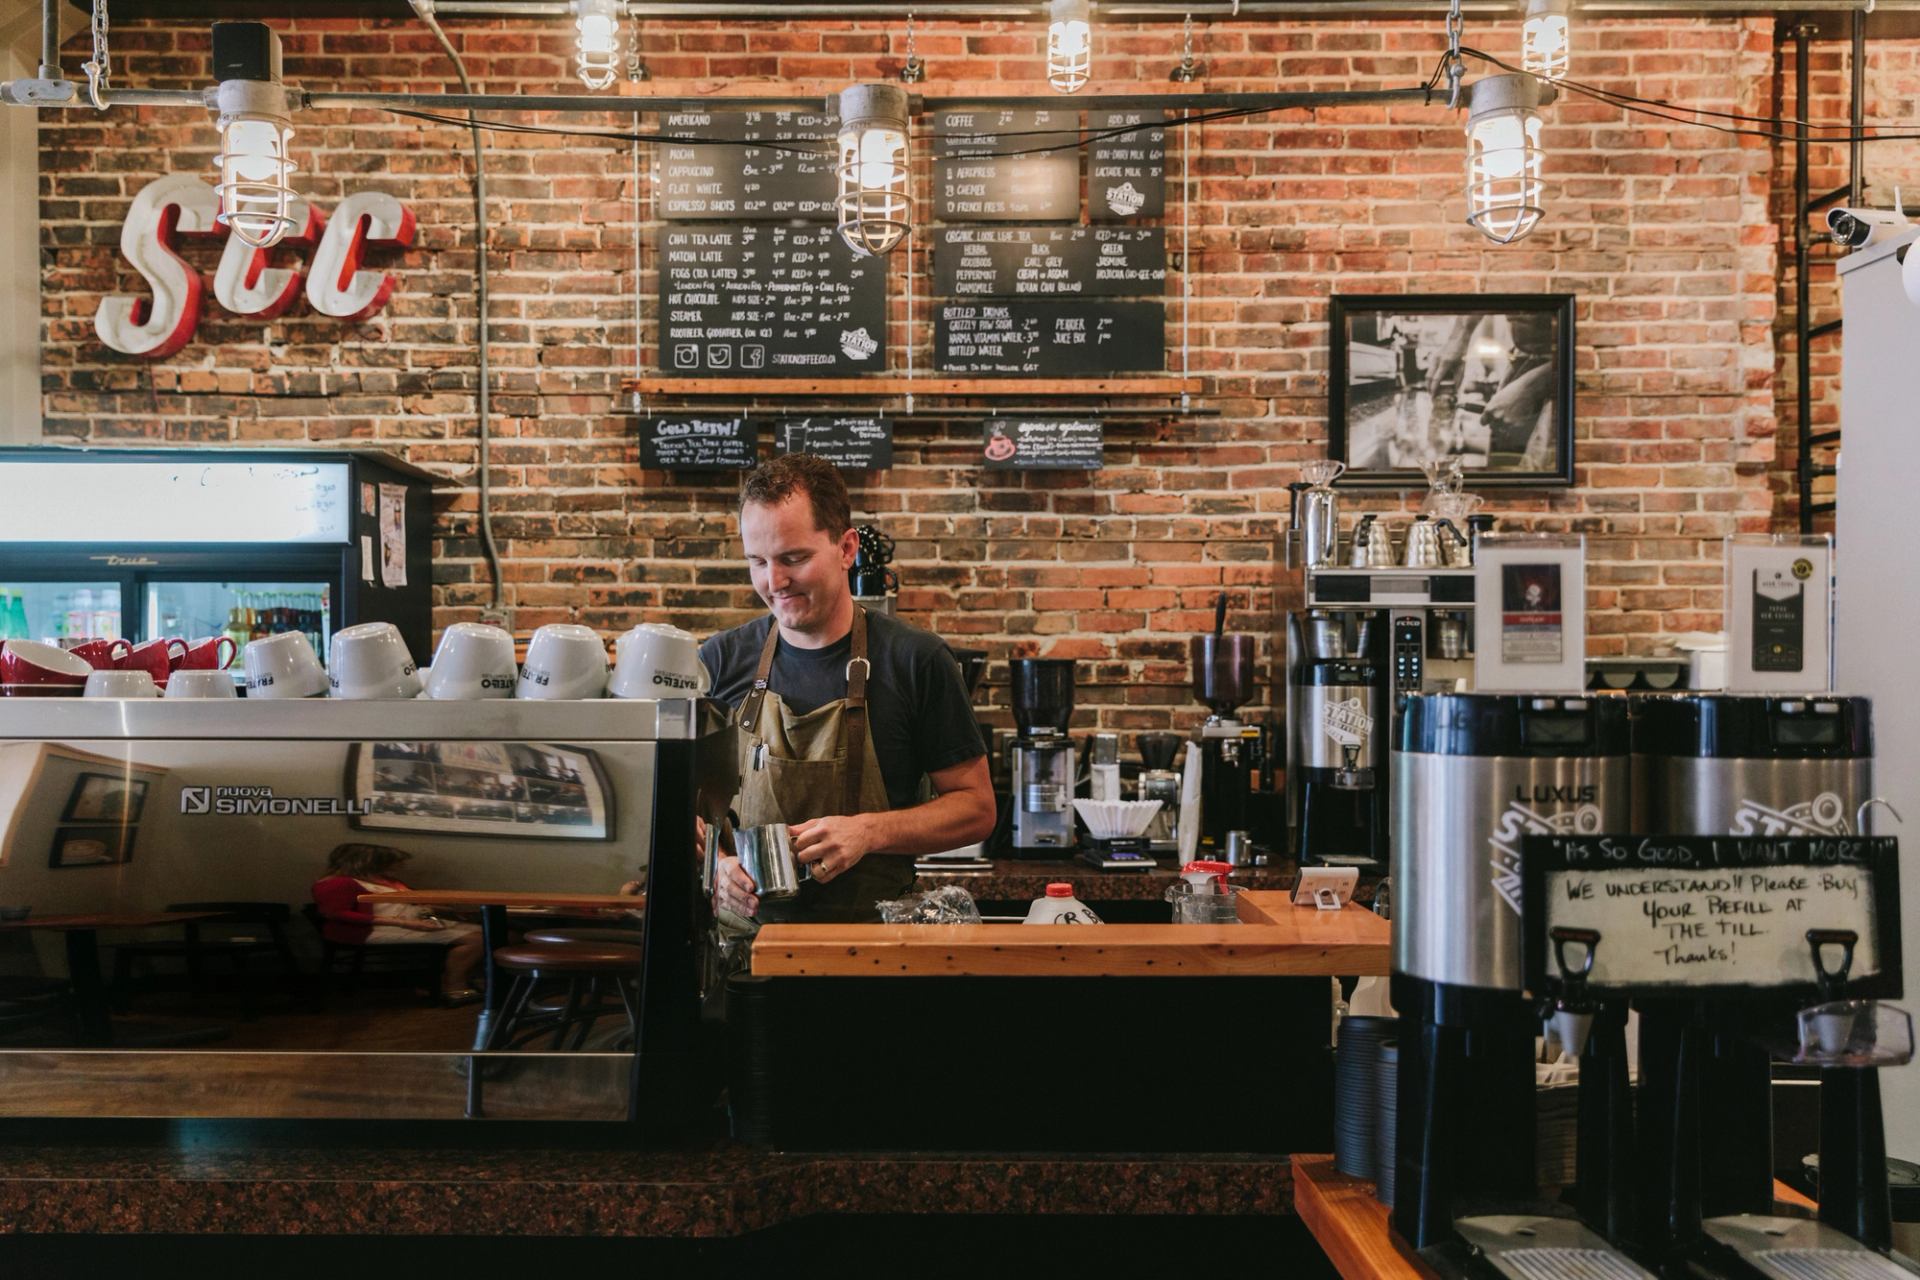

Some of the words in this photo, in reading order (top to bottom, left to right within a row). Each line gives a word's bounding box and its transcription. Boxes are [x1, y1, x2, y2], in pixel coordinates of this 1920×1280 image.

[668, 114, 711, 126] AMERICANO
[945, 115, 975, 127] COFFEE
[669, 148, 695, 160] MOCHA
[668, 166, 714, 177] CAPPUCCINO
[668, 183, 690, 194] FLAT
[696, 183, 723, 194] WHITE
[956, 184, 986, 196] CHEMEX
[1106, 187, 1145, 206] STATION
[668, 200, 707, 212] ESPRESSO
[710, 200, 736, 211] SHOTS
[668, 233, 688, 246] CHAI
[691, 233, 709, 245] TEA
[710, 233, 734, 246] LATTE
[945, 230, 974, 242] ORGANIC
[976, 231, 995, 241] LOOSE
[1101, 243, 1124, 256] GREEN
[668, 250, 697, 263] MATCHA
[700, 251, 723, 262] LATTE
[1045, 256, 1063, 268] GREY
[1096, 256, 1129, 267] JASMINE
[670, 268, 691, 279] FOGS
[956, 269, 998, 280] PEPPERMINT
[1016, 268, 1039, 280] CREAM
[955, 282, 994, 294] CHAMOMILE
[668, 293, 682, 305] HOT
[684, 293, 721, 305] CHOCOLATE
[670, 310, 703, 322] STEAMER
[943, 307, 976, 319] BOTTLED
[983, 307, 1009, 318] DRINKS
[949, 319, 977, 331] GRIZZLY
[979, 320, 994, 331] PAW
[995, 319, 1013, 330] SODA
[706, 327, 744, 339] GODFATHER
[948, 332, 973, 344] KARMA
[973, 332, 1000, 344] VITAMIN
[1001, 331, 1024, 343] WATER
[1052, 332, 1072, 344] JUICE
[1073, 332, 1087, 344] BOX
[840, 331, 878, 354] STATION
[948, 345, 977, 357] BOTTLED
[978, 345, 1004, 357] WATER
[215, 786, 272, 798] nuova
[1514, 784, 1598, 803] LUXUS
[215, 798, 371, 815] SIMONELLI
[1785, 898, 1807, 914] AT
[1665, 920, 1705, 941] THE
[1653, 942, 1738, 968] Thanks!
